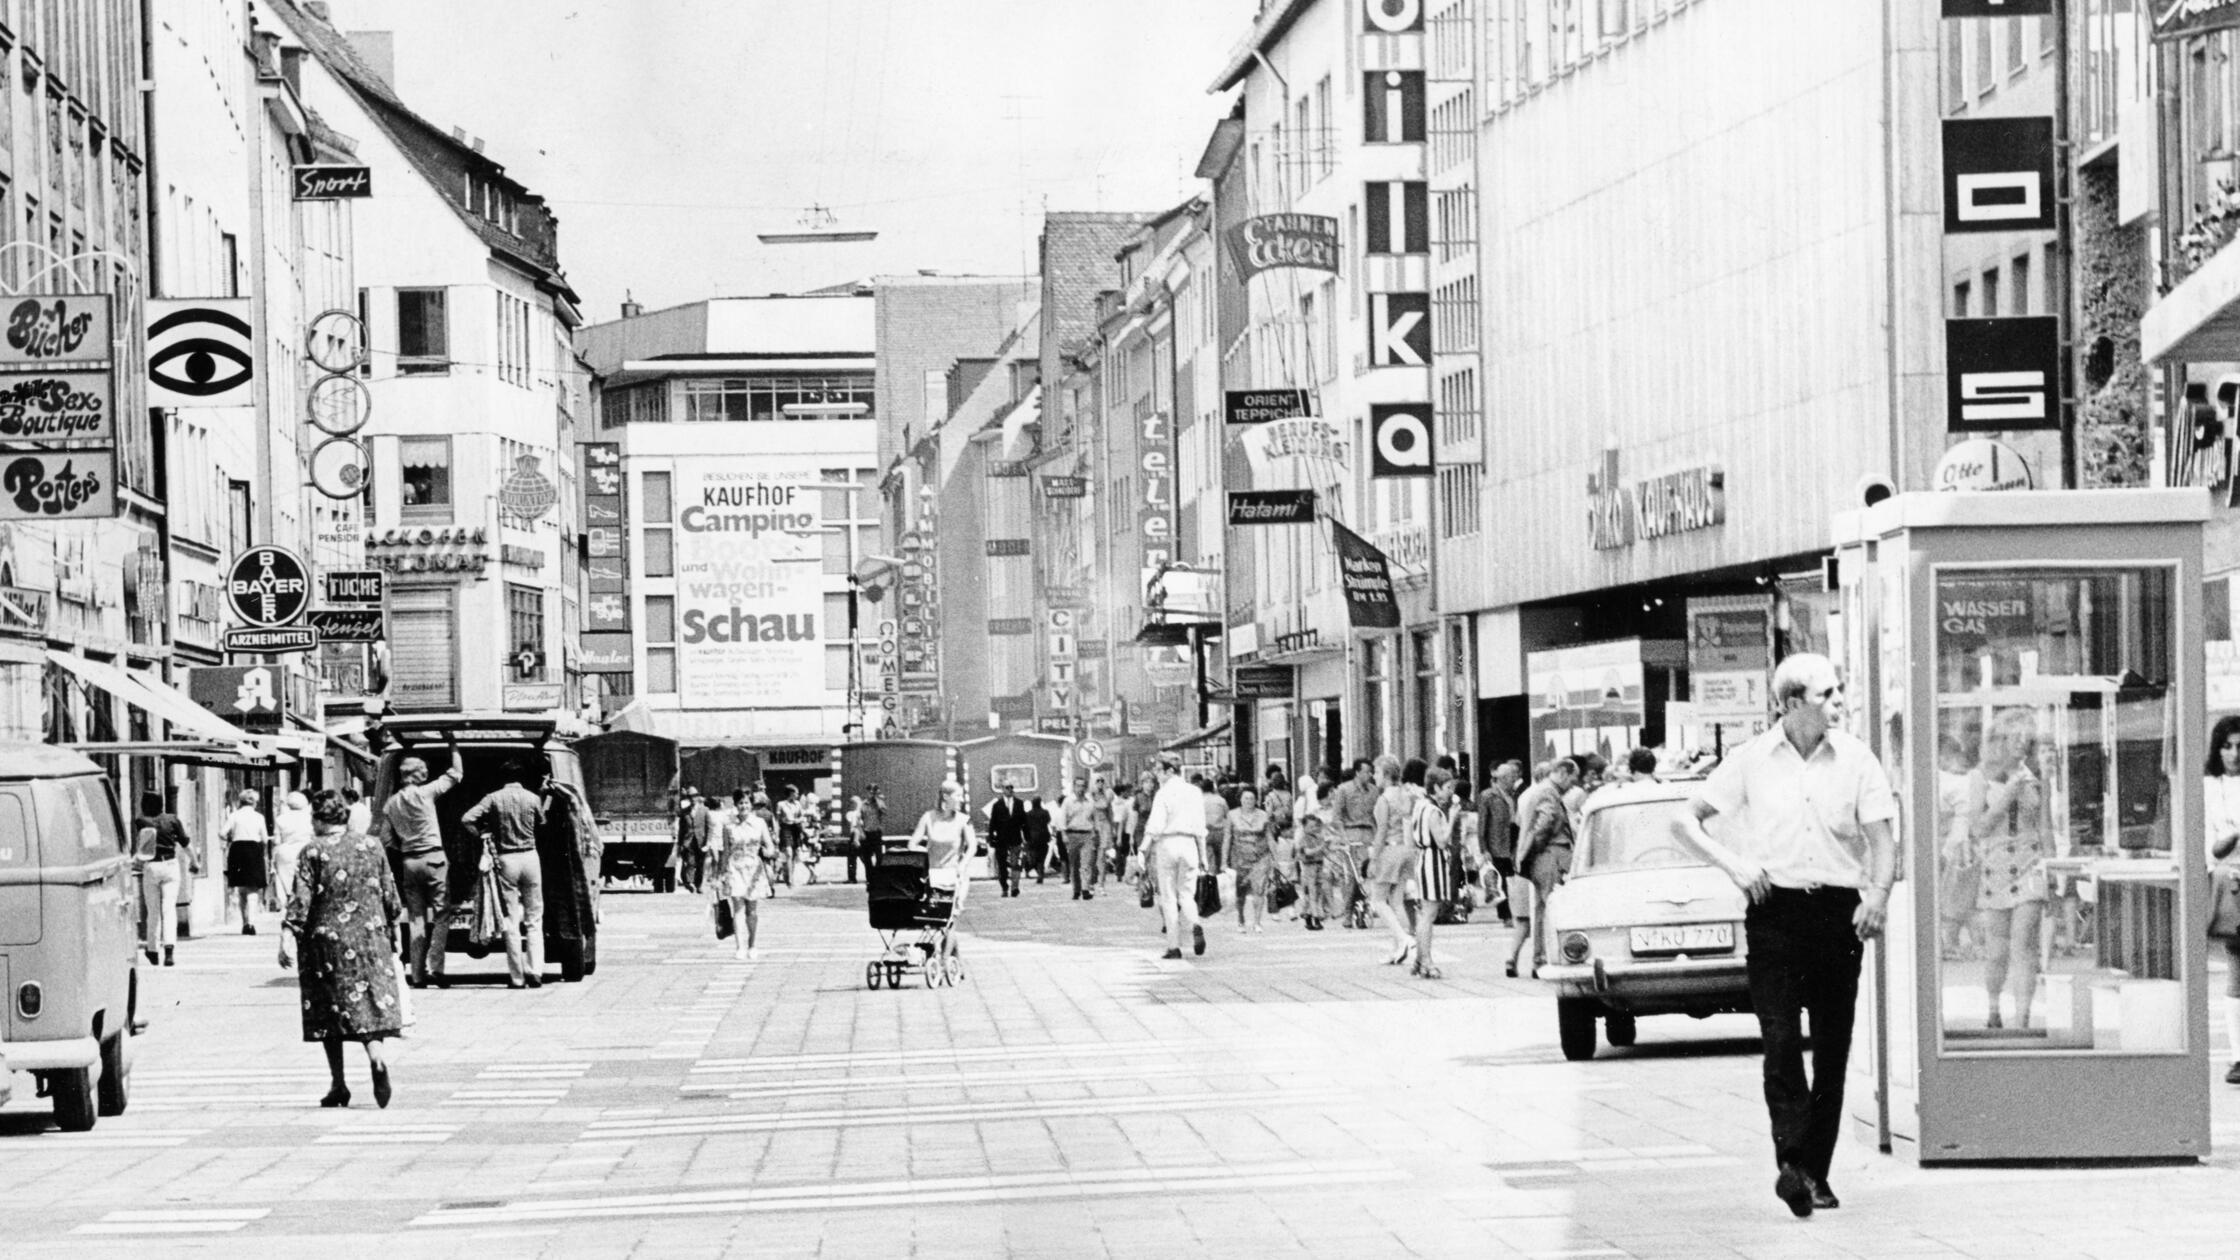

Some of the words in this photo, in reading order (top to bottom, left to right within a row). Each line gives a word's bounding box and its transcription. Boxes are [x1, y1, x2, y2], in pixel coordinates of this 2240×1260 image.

[300, 170, 368, 197] Sport
[7, 299, 93, 358] Bücher
[38, 381, 102, 412] Sex
[1244, 393, 1296, 408] ORIENT
[0, 404, 102, 437] Boutique
[681, 506, 813, 539] Camping
[1231, 499, 1300, 518] Hatami
[681, 563, 708, 573] und
[232, 577, 304, 595] BAYER
[258, 551, 277, 622] BAYER
[329, 577, 380, 597] TUCHE
[230, 632, 311, 647] ARZNEIMITTEL
[683, 606, 816, 644] Schau
[1943, 617, 1986, 634] GAS
[1051, 610, 1072, 705] CITY
[880, 639, 897, 729] OMEGA
